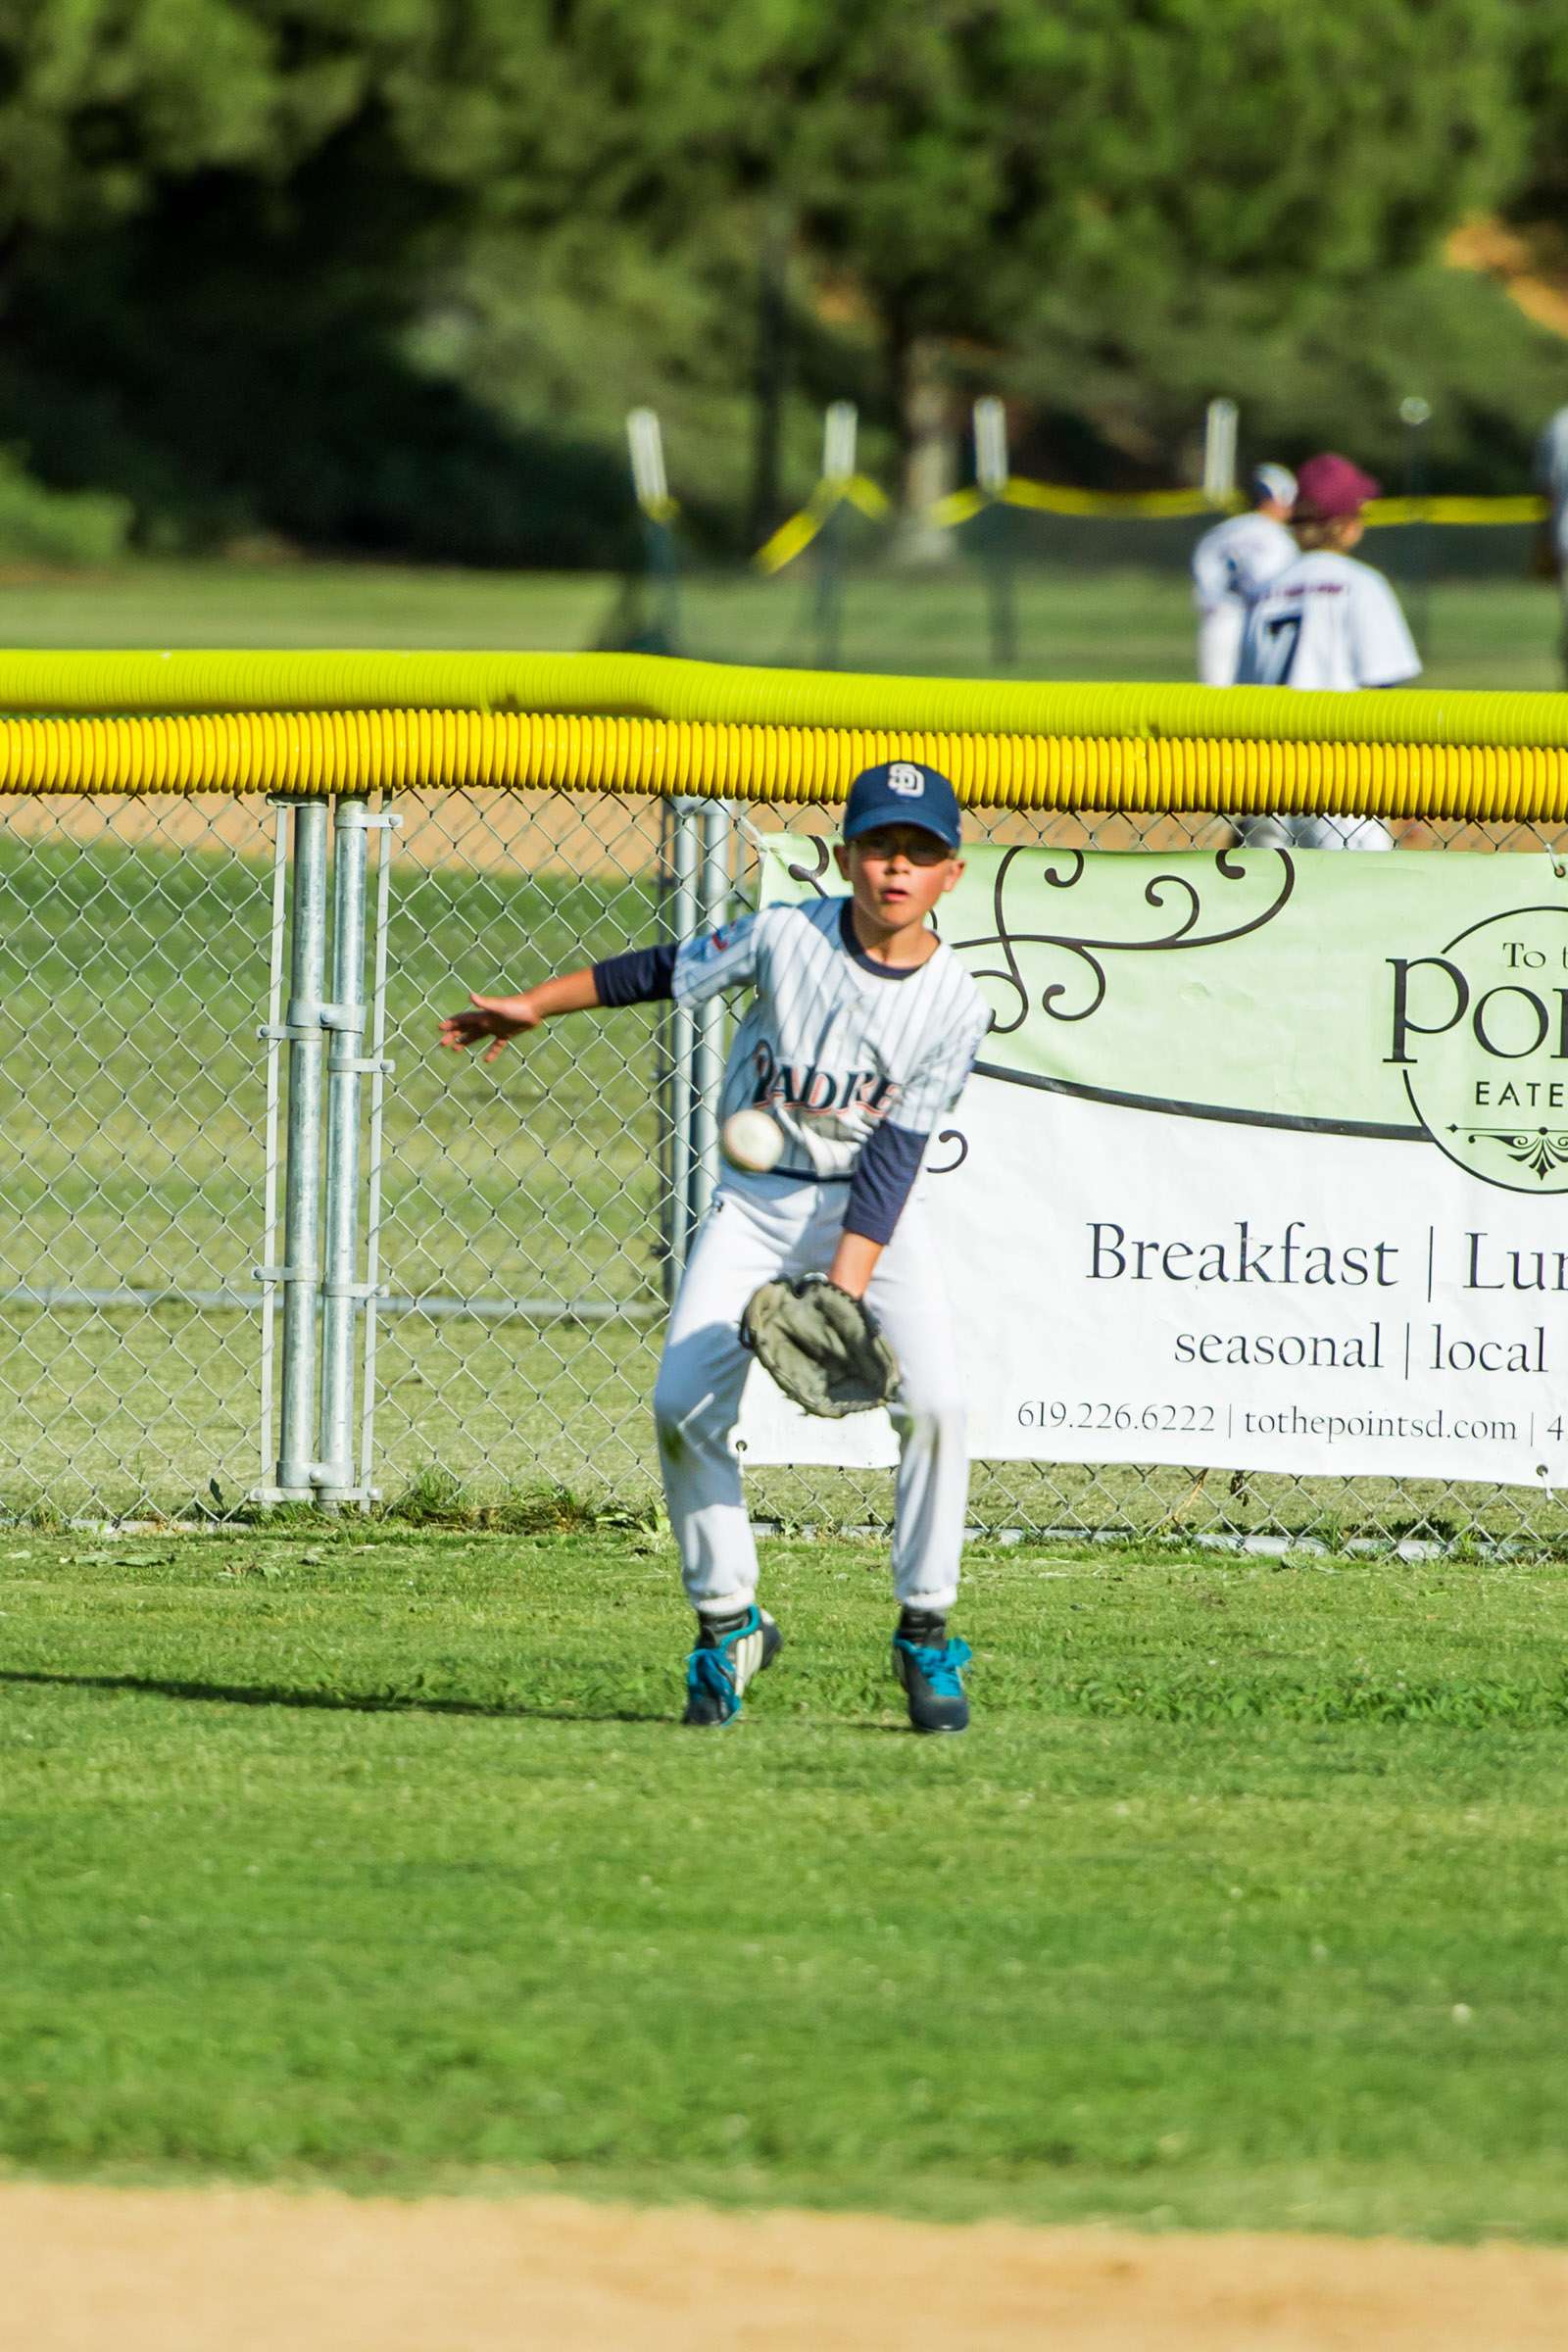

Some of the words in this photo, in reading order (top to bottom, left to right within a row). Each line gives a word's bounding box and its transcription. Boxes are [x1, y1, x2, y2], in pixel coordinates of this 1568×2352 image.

[888, 762, 925, 798] SD
[1502, 942, 1546, 968] To
[1475, 1081, 1564, 1107] EATE
[1086, 1220, 1399, 1287] Breakfast
[1173, 1321, 1384, 1368] seasonal
[1429, 1323, 1548, 1373] local
[1016, 1400, 1215, 1432] 619.226.6222
[1245, 1403, 1517, 1444] tothepointsd.com
